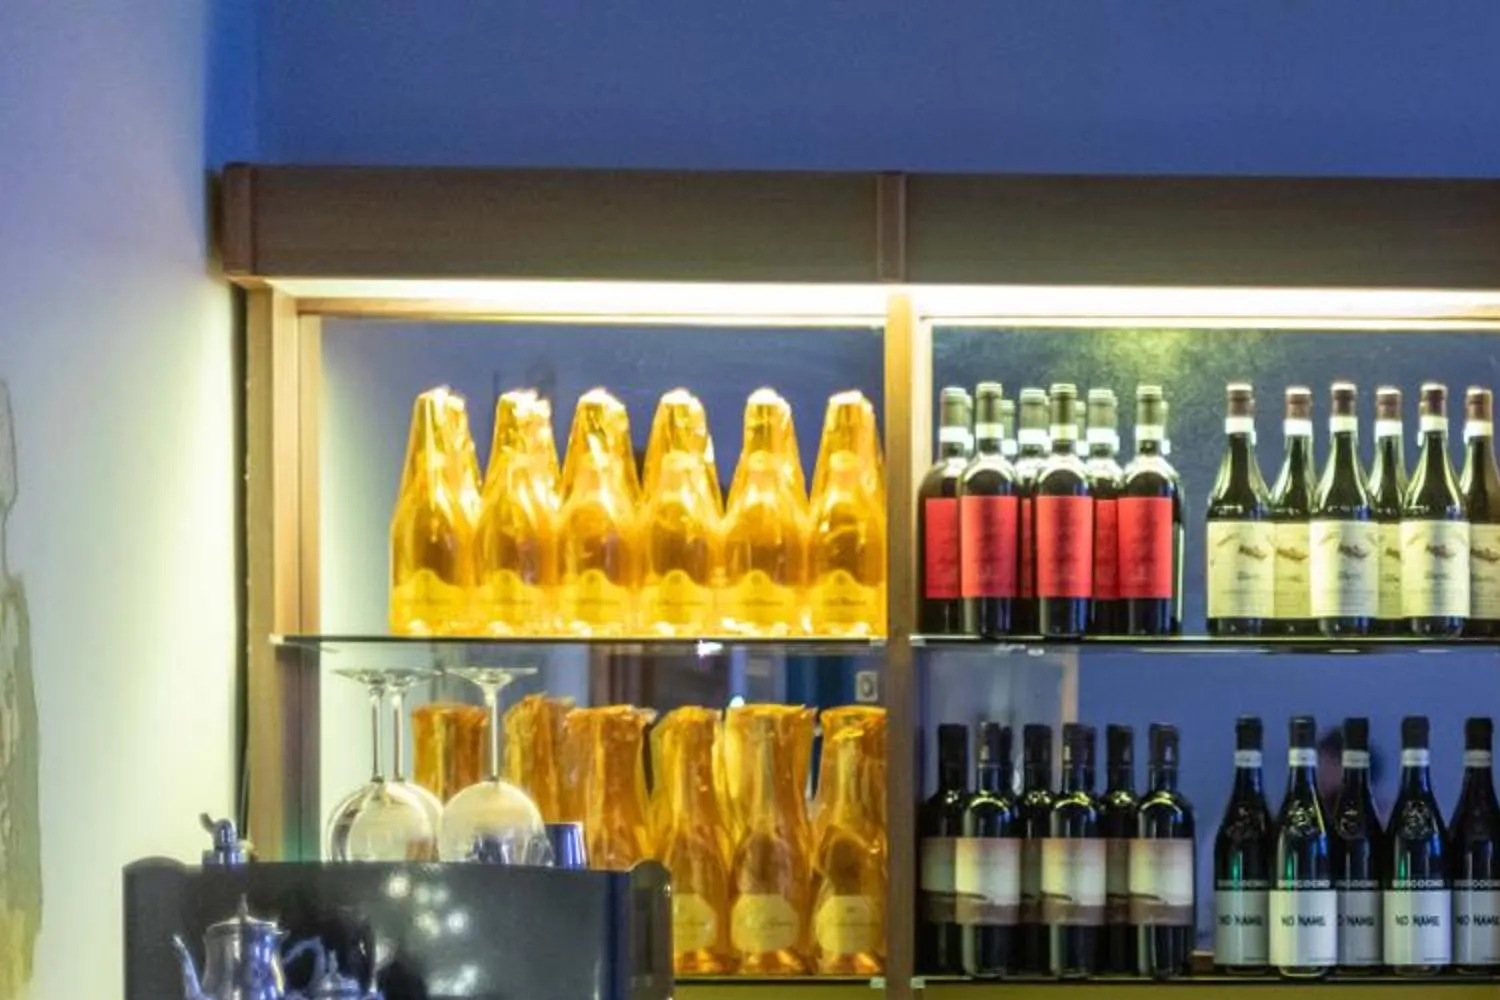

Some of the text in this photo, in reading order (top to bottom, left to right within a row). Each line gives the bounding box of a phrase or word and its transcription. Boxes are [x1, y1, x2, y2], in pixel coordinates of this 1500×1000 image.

[1281, 914, 1328, 926] NO NAME
[1346, 914, 1375, 926] NAME
[1395, 914, 1441, 926] NO NAME
[1456, 914, 1500, 926] NO NAME
